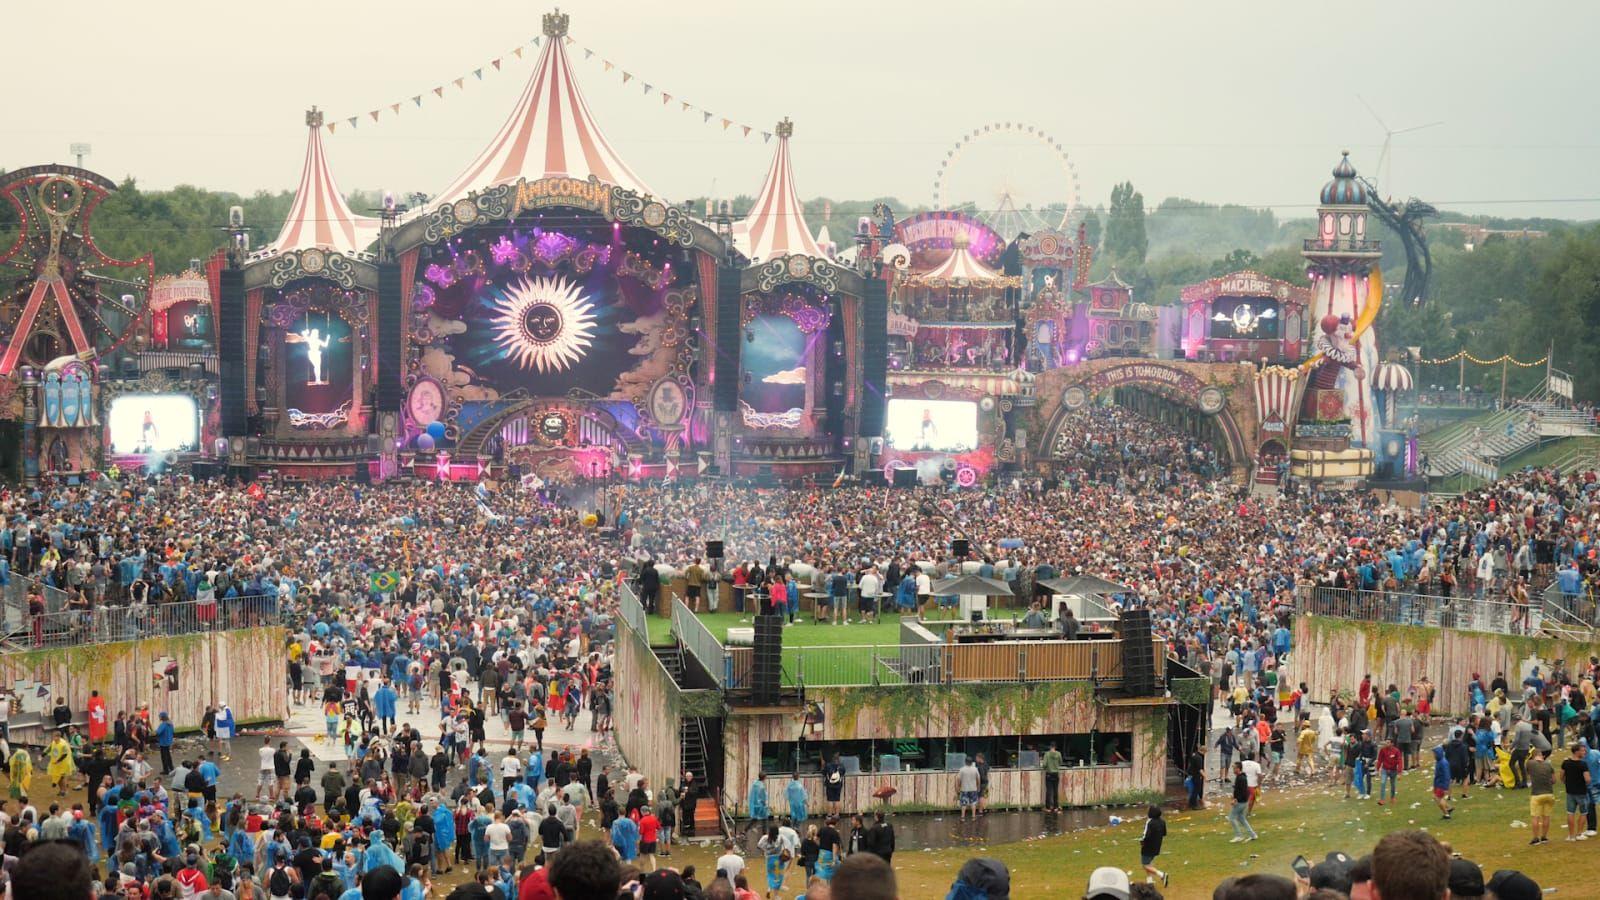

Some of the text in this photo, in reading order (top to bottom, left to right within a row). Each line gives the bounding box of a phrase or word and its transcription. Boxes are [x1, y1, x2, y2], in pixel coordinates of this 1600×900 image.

[511, 177, 611, 216] AMICORUM
[1221, 279, 1272, 293] MACABRE
[1106, 365, 1182, 384] THIS IS TOMORROW
